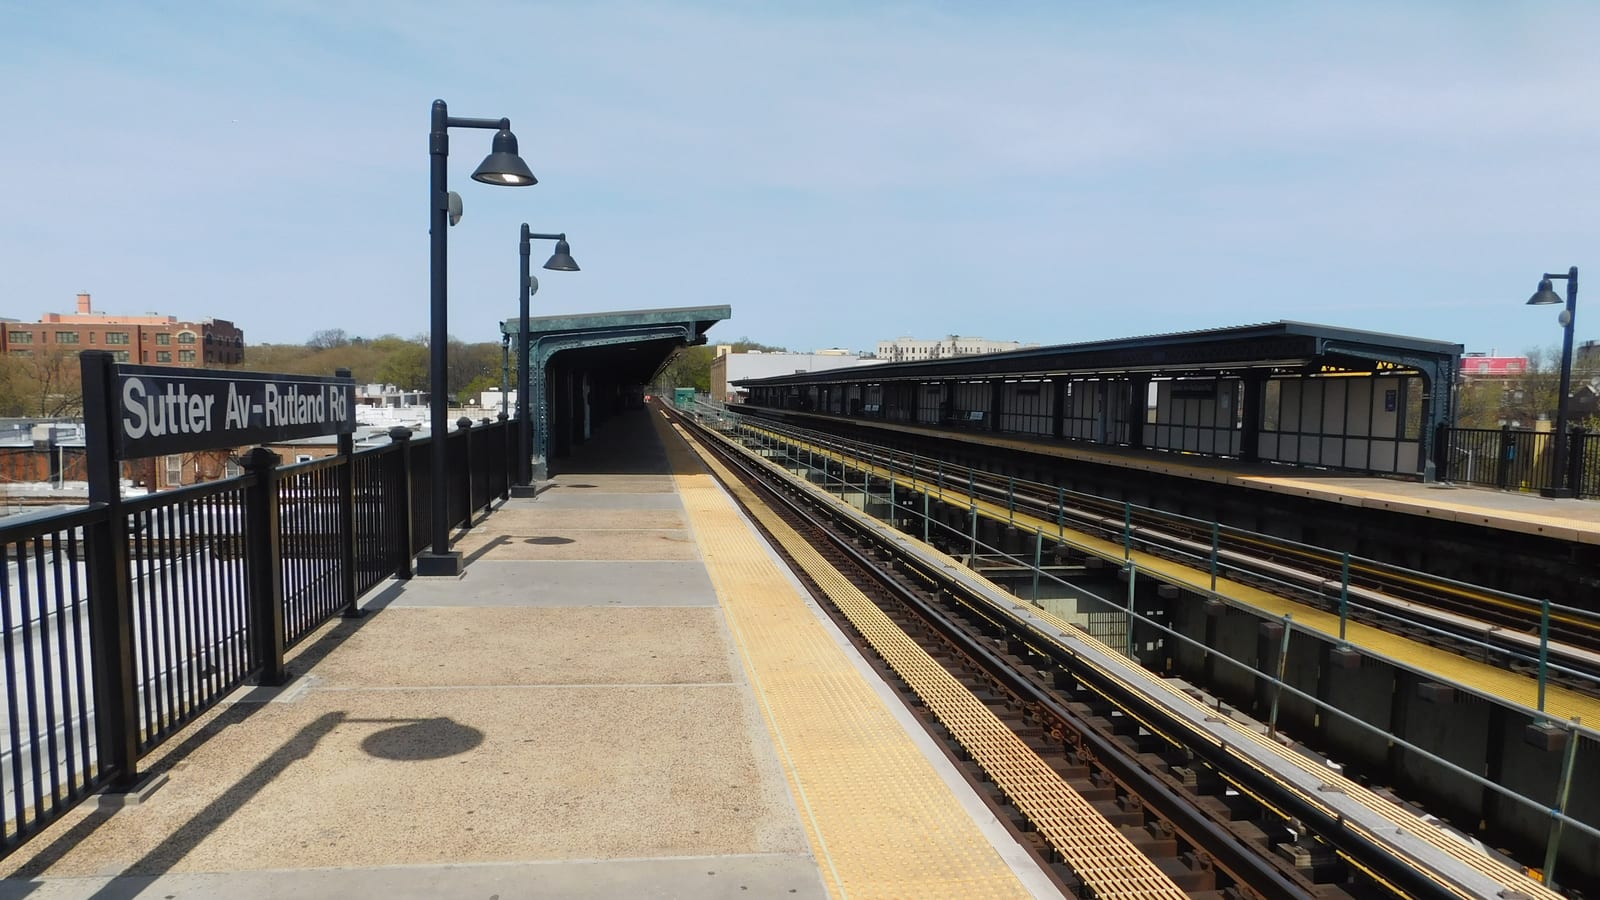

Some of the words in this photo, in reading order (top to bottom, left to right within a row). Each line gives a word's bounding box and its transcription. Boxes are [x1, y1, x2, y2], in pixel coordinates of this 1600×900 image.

[123, 377, 214, 440] Sutter
[225, 382, 325, 430] Av-Rutland
[330, 386, 347, 422] Rd
